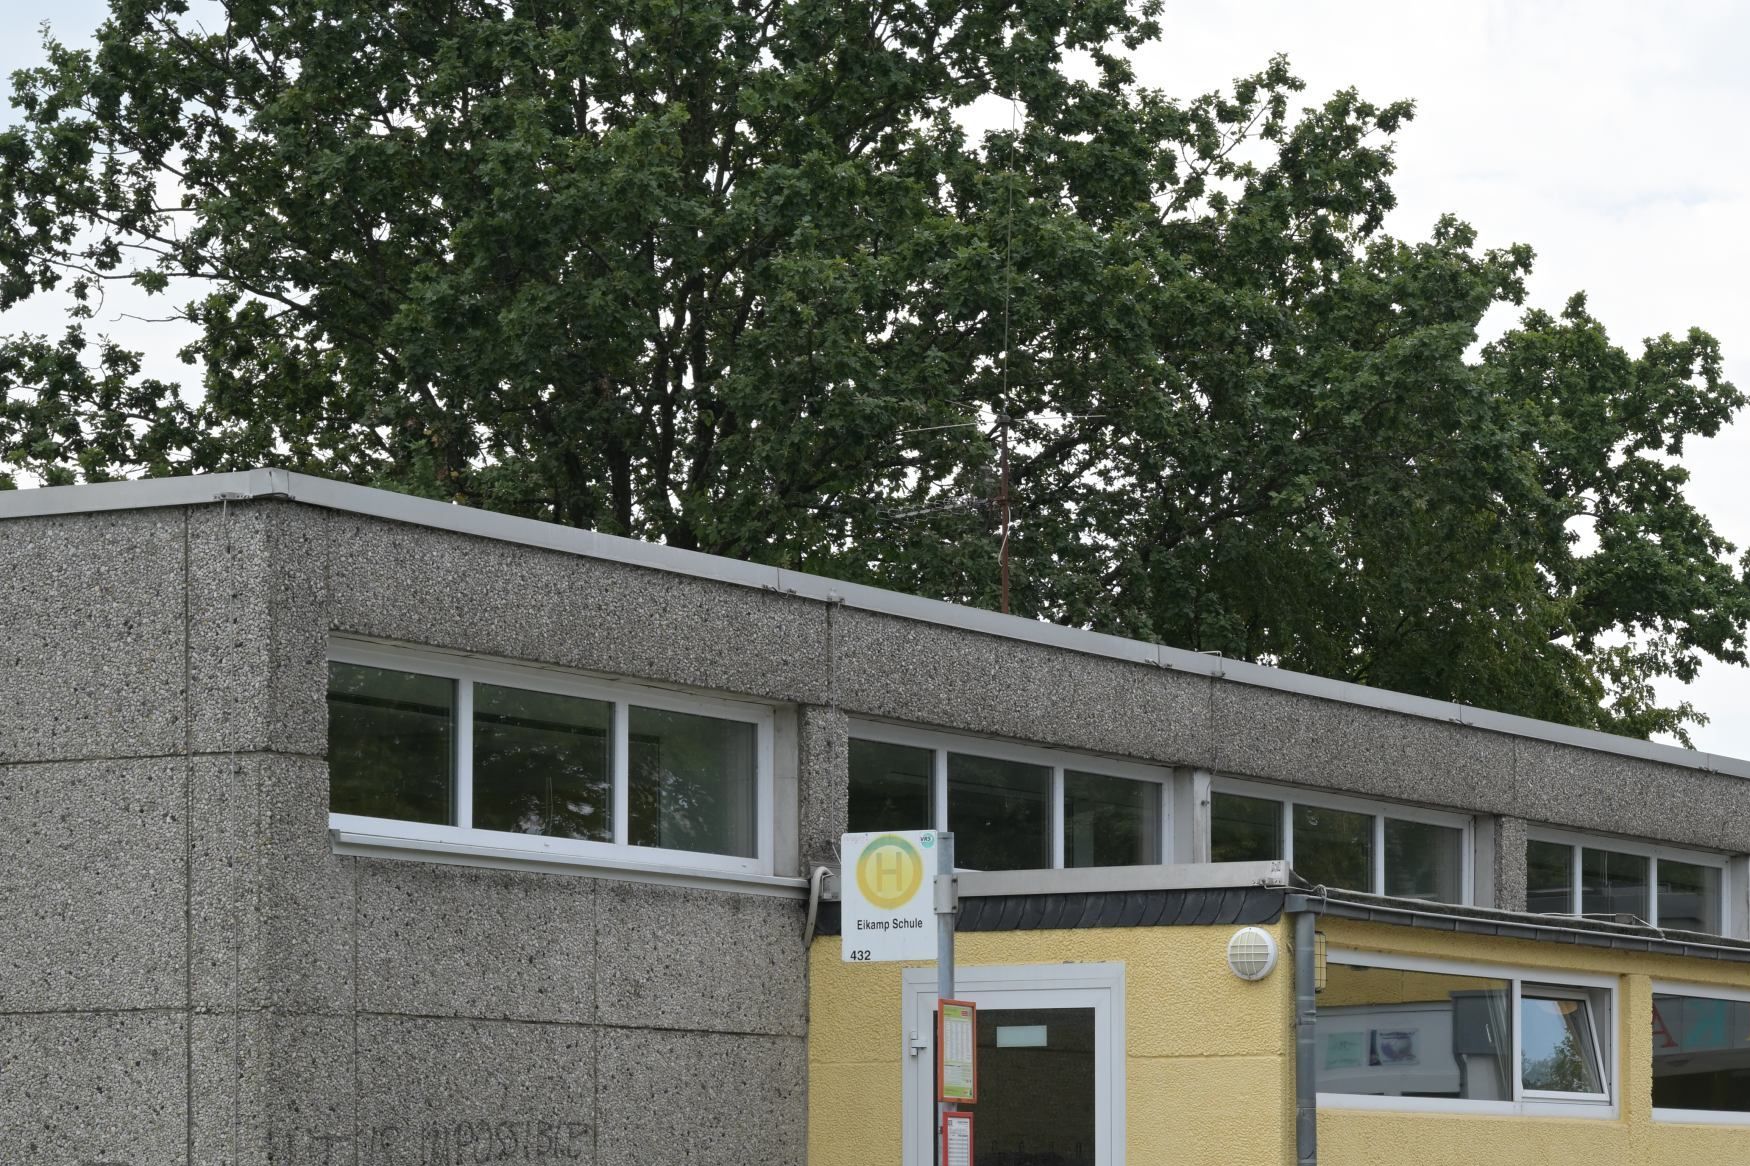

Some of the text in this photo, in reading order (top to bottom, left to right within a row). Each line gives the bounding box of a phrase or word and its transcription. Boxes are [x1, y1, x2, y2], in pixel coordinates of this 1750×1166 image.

[876, 851, 902, 892] H
[857, 918, 923, 931] Eikamp Schule
[850, 950, 871, 960] 432
